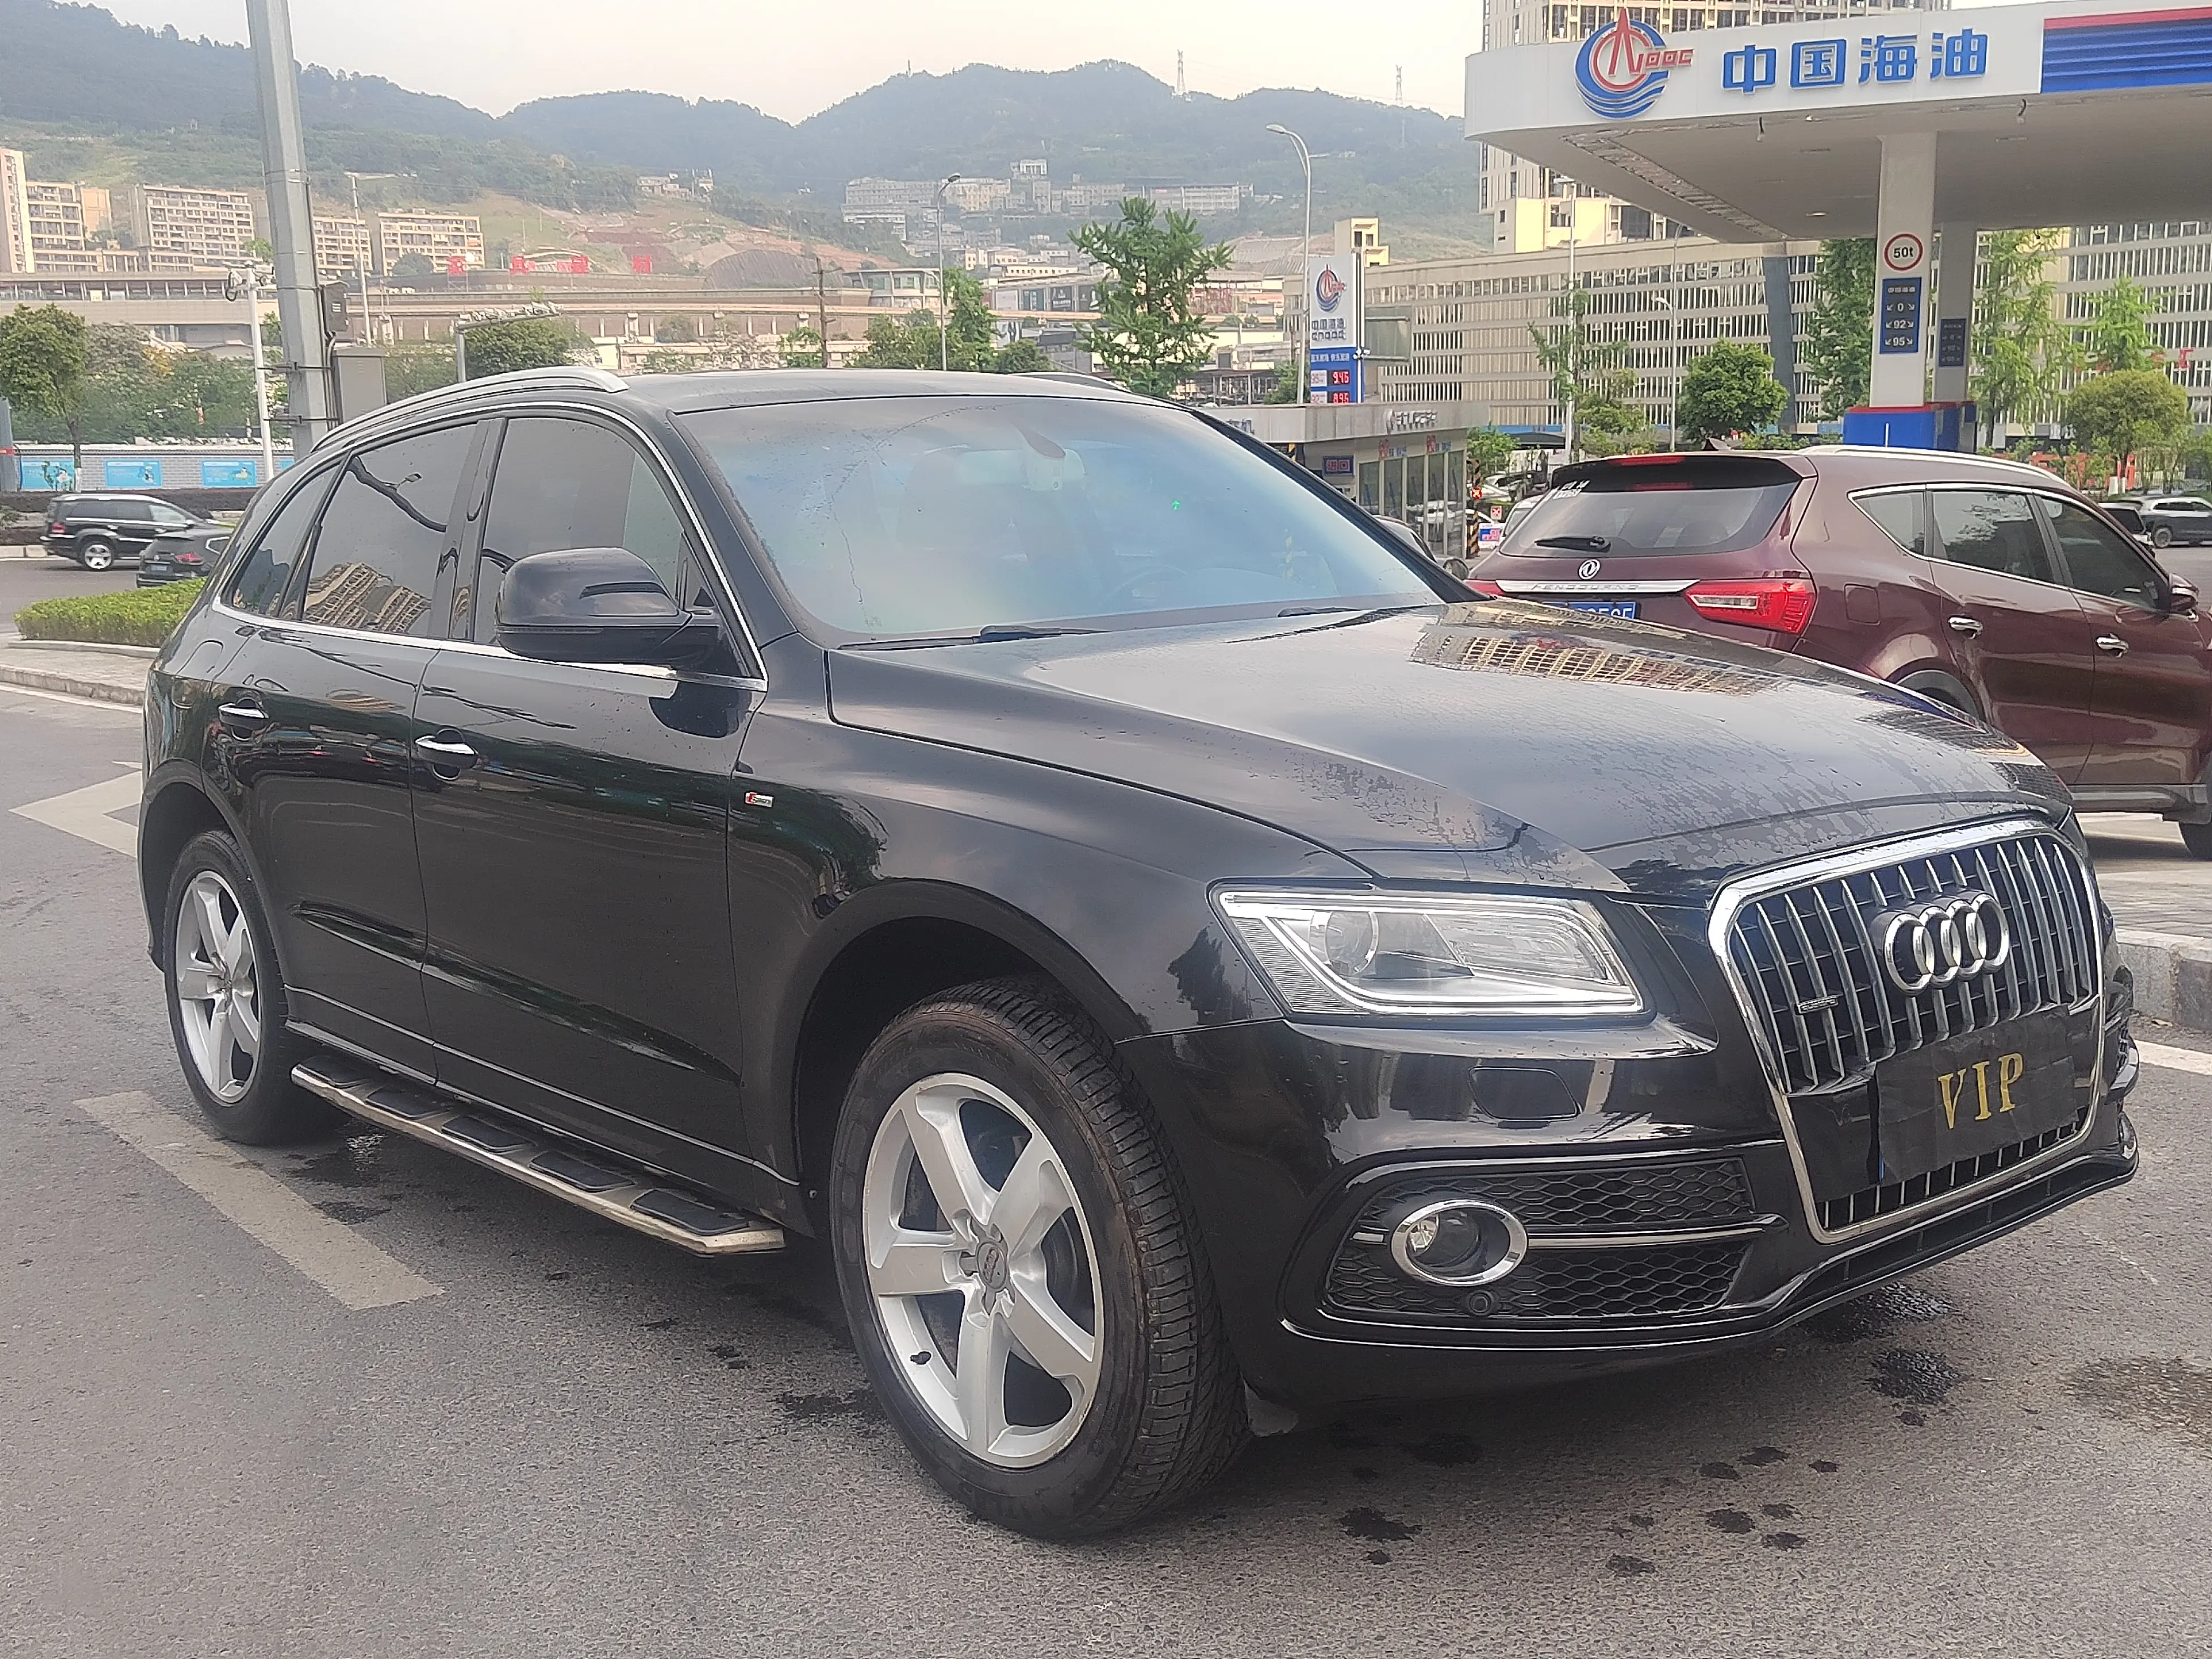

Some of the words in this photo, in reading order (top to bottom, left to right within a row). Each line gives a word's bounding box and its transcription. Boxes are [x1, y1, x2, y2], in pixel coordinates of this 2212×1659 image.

[1722, 28, 1988, 93] 中国海油
[1894, 247, 1913, 258] 50t
[1938, 1052, 2023, 1130] VIP
